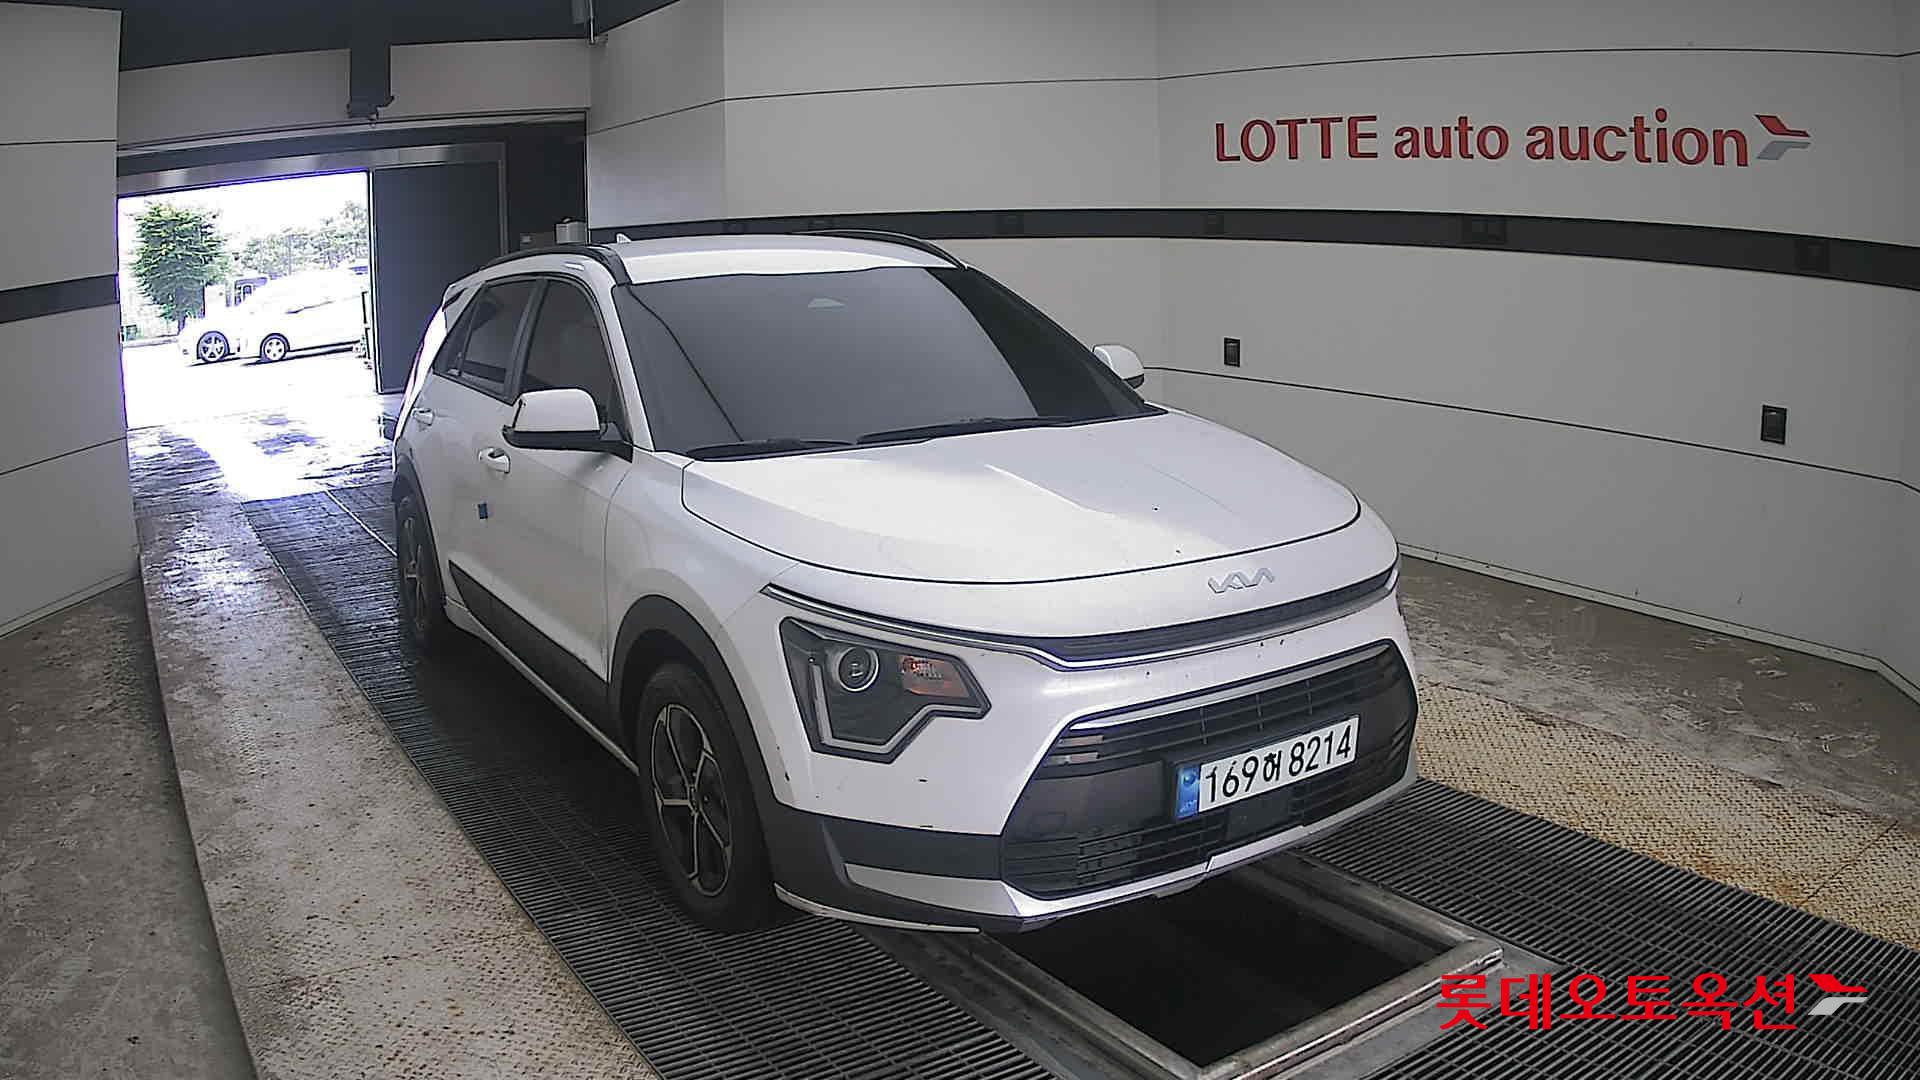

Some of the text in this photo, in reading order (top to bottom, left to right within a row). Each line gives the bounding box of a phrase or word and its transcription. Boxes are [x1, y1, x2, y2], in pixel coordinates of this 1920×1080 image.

[1214, 108, 1749, 167] LOTTE auto auction
[1205, 725, 1352, 803] 169허 8214
